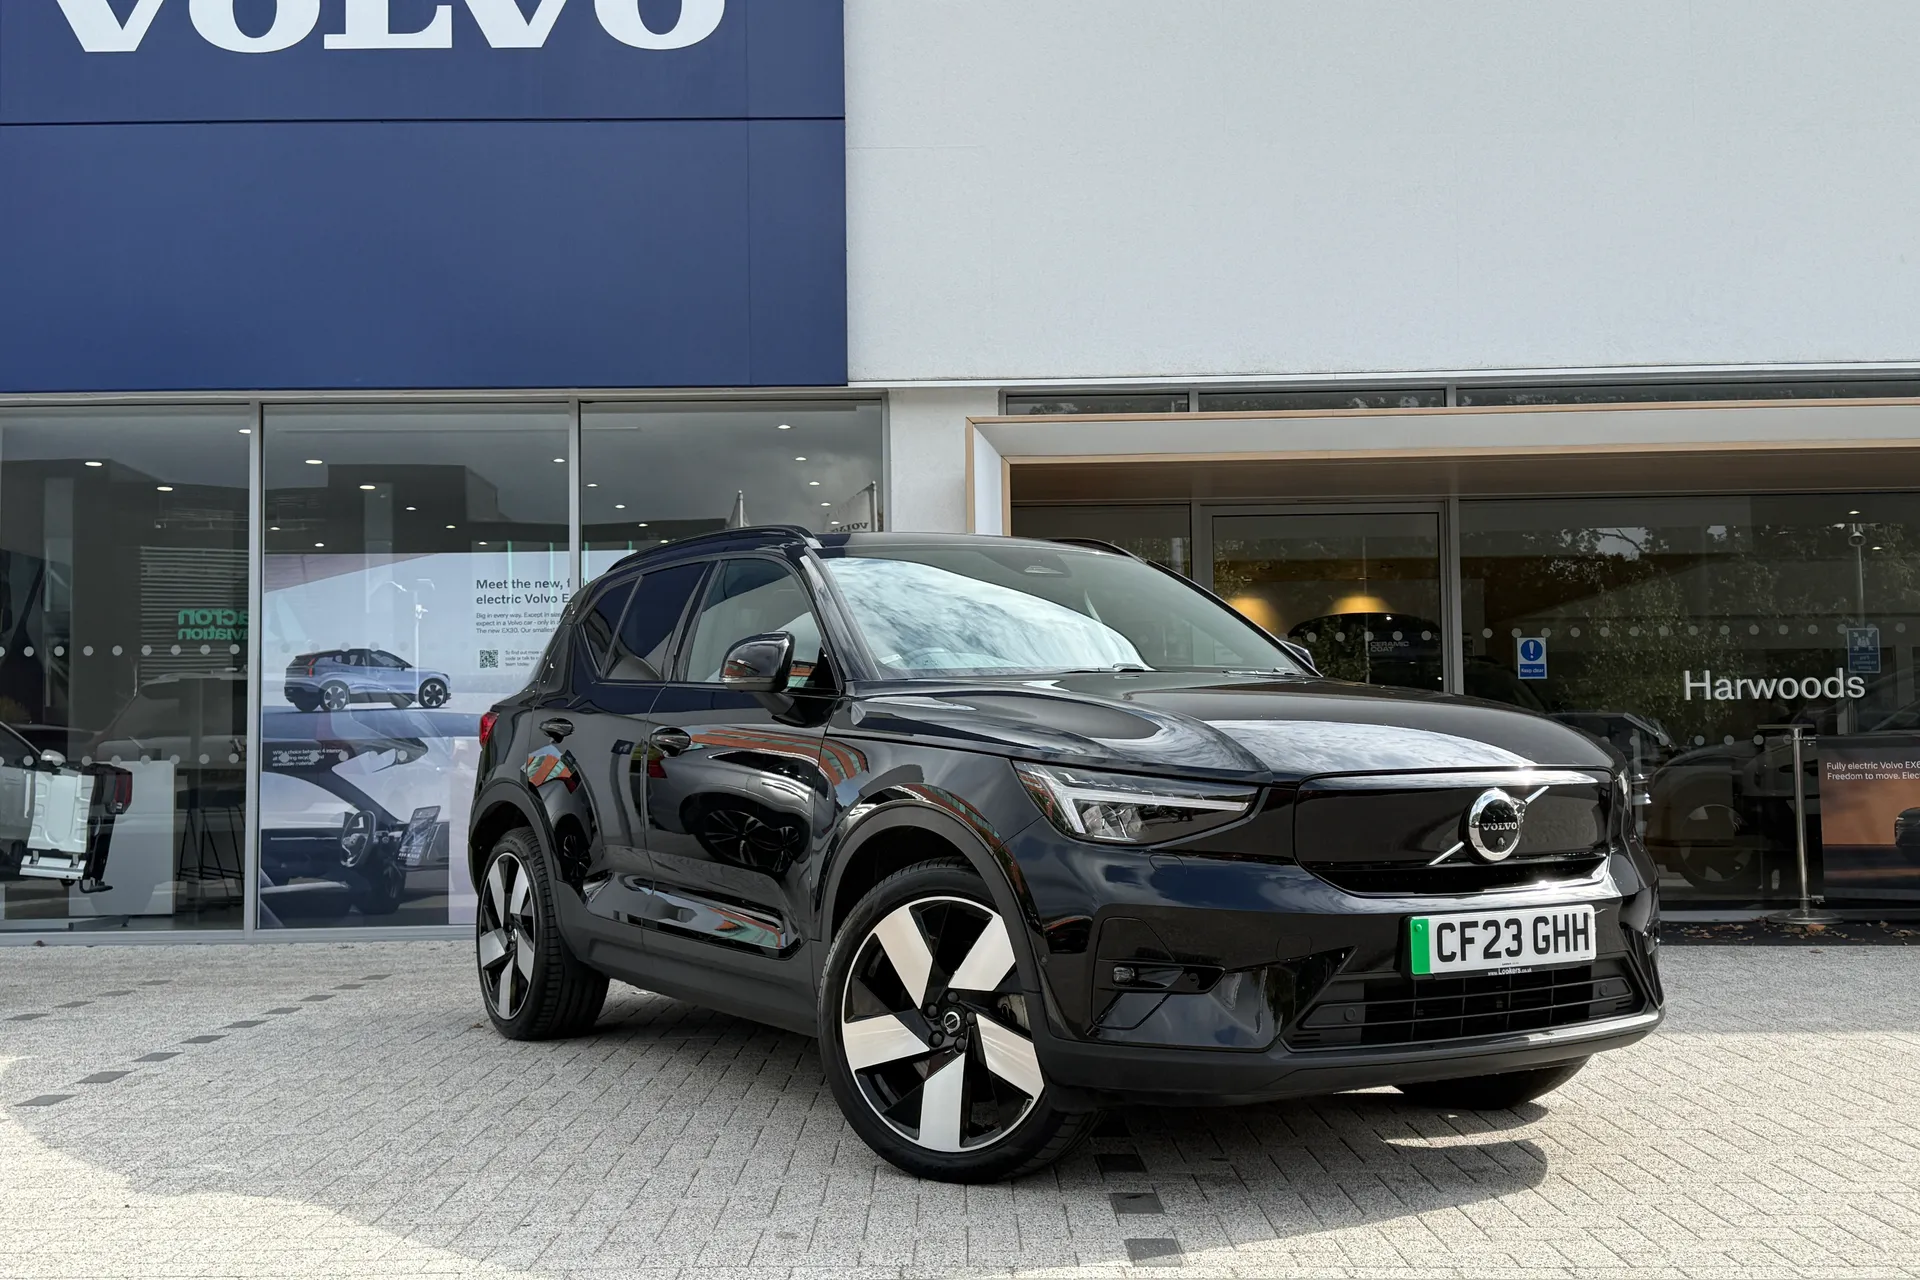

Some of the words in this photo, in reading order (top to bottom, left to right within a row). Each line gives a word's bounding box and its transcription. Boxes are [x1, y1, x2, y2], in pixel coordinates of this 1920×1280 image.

[476, 580, 508, 589] Meet
[511, 579, 531, 589] the
[535, 580, 563, 590] new,
[476, 594, 522, 604] electric
[525, 593, 558, 604] Volvo
[524, 612, 544, 620] Except
[1684, 667, 1866, 701] Harwoods
[1827, 762, 1846, 772] Fully
[1848, 762, 1878, 770] electric
[1880, 761, 1904, 769] Volvo
[1828, 772, 1863, 780] Freedom
[1865, 772, 1874, 780] to
[1481, 822, 1518, 831] VOLVO
[1437, 918, 1523, 963] CF23
[1533, 912, 1590, 956] GHH
